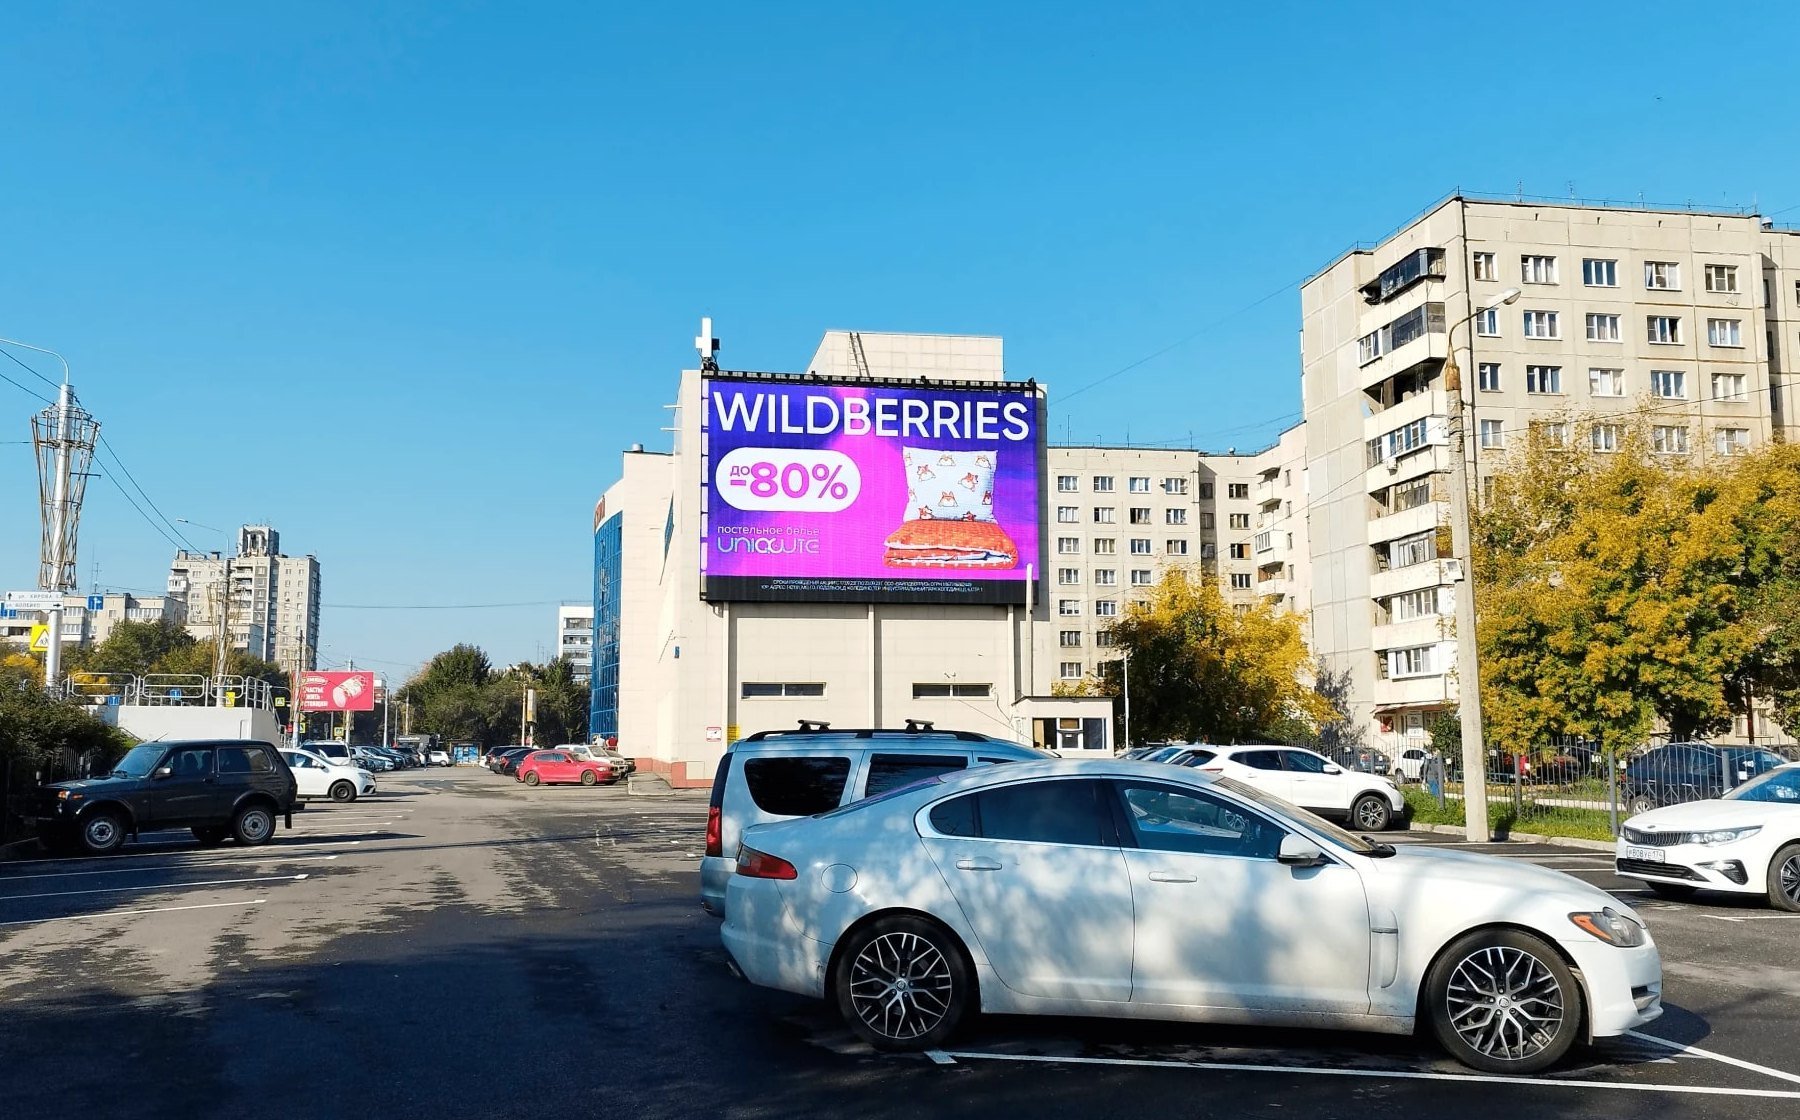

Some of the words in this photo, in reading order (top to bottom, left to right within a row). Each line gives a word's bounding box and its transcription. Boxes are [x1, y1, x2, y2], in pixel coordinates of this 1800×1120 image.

[713, 391, 1030, 441] WILDBERRIES
[730, 462, 848, 500] -80%
[717, 525, 783, 535] постельное
[786, 526, 819, 536] белье
